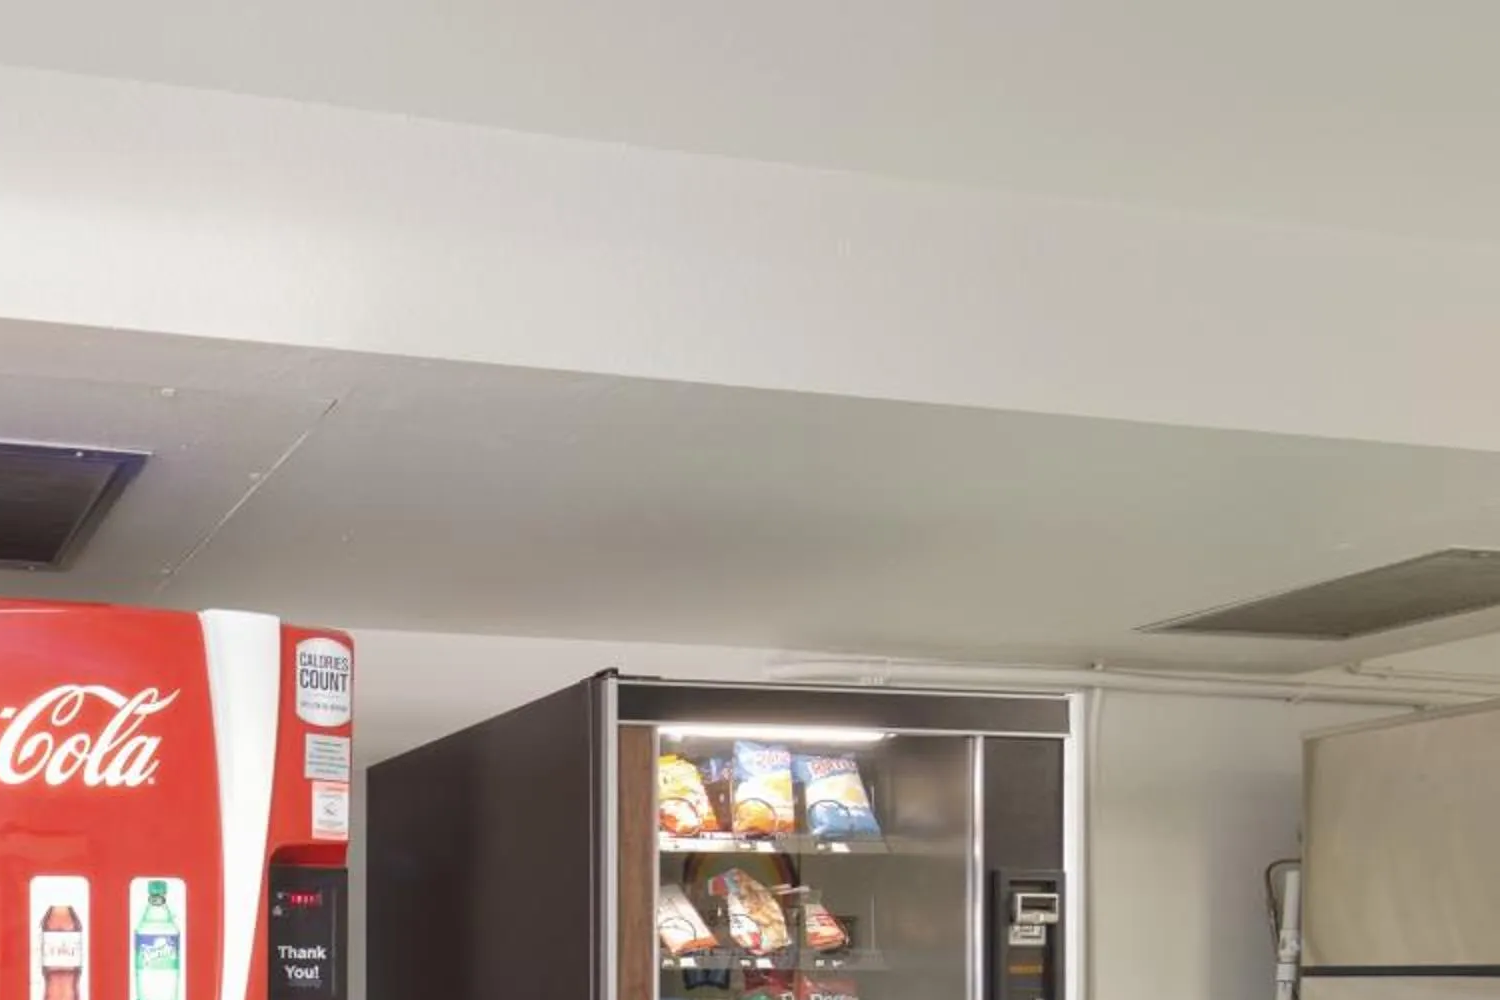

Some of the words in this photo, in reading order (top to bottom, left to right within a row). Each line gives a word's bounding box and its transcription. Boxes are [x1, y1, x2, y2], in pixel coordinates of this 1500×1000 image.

[300, 651, 349, 671] CALORIES
[300, 668, 349, 692] COUNT
[277, 945, 327, 960] Thank
[284, 964, 320, 979] You!
